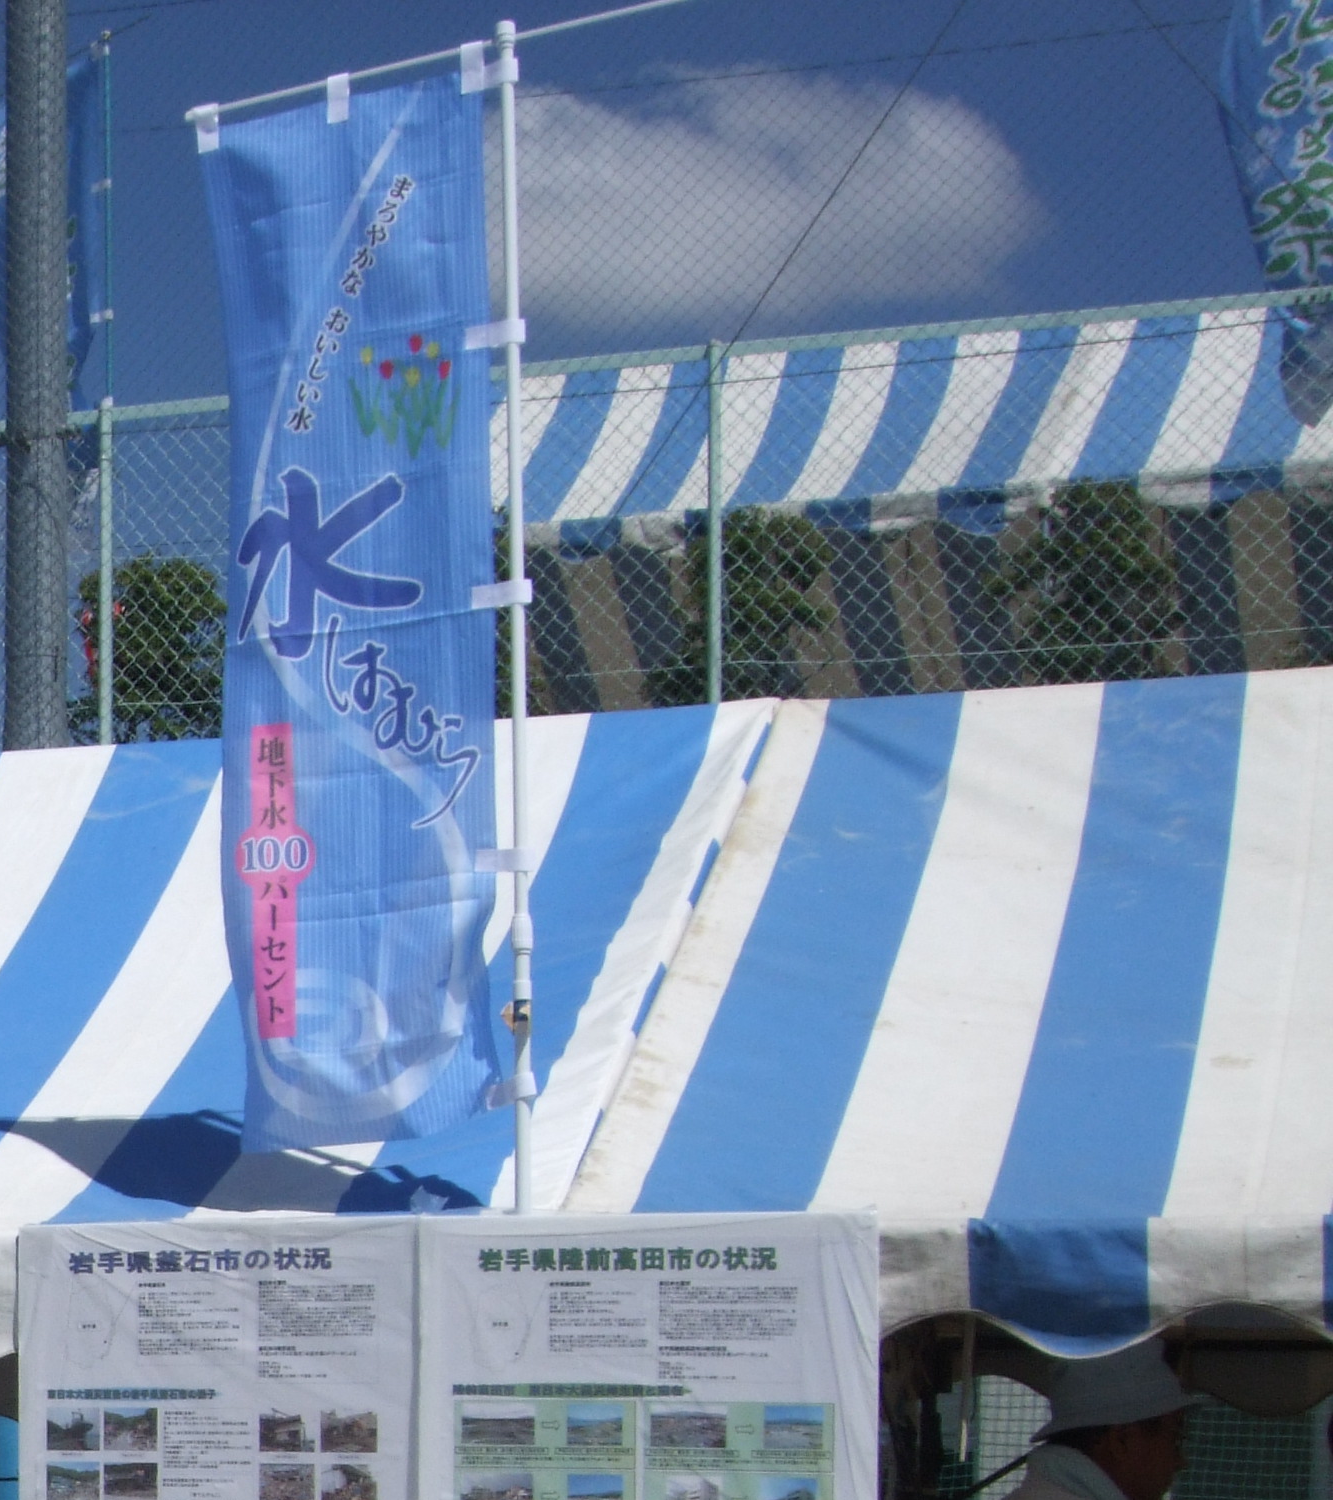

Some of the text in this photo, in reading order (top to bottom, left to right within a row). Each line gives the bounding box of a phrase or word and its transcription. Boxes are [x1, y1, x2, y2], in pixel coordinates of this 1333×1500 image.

[285, 175, 412, 434] まろやかな おいしい水
[69, 1247, 332, 1275] 岩手県釜石市の状況
[478, 1246, 777, 1273] 岩手県陸前高田市の状況
